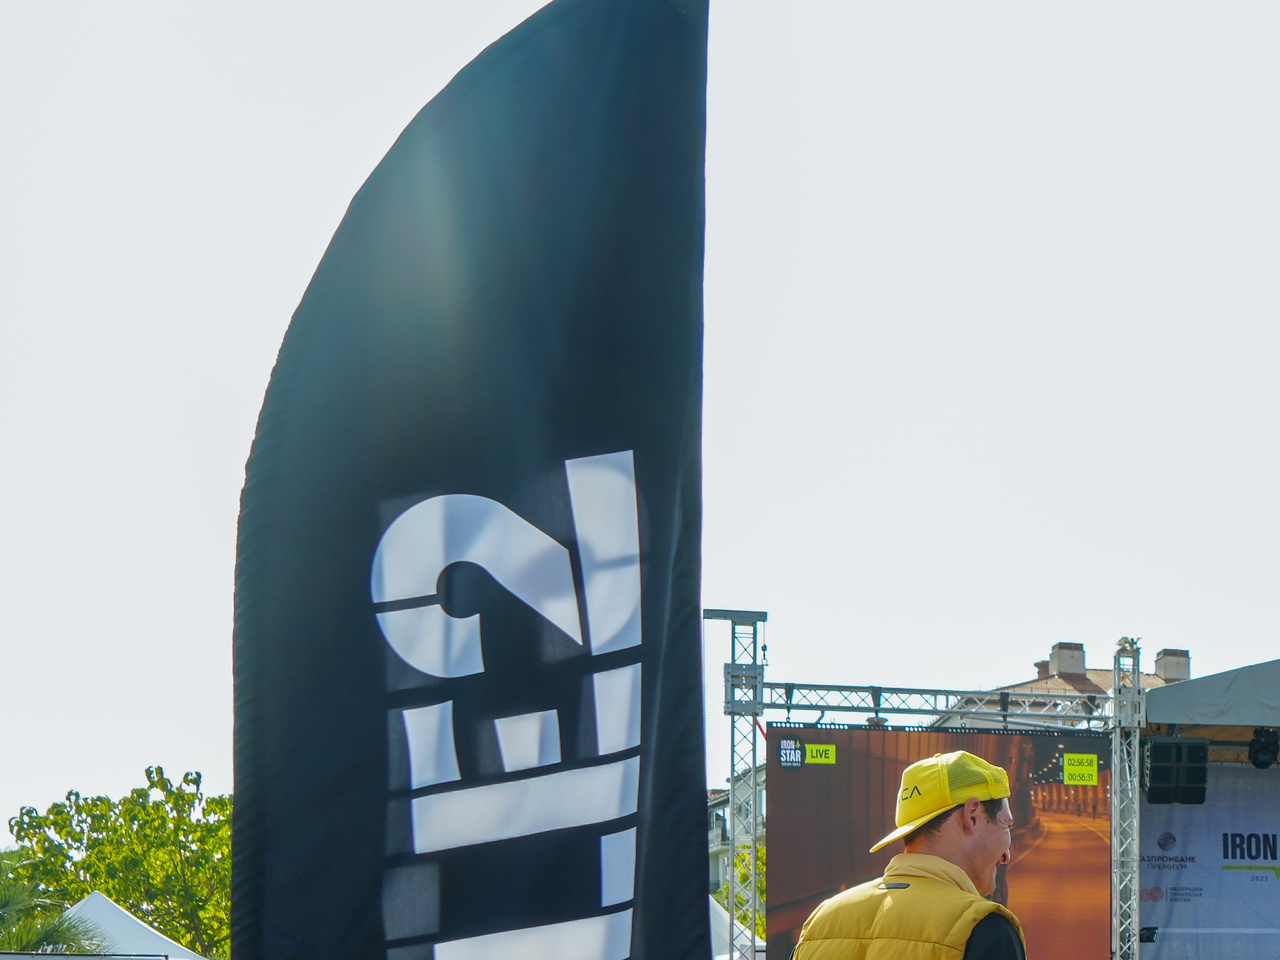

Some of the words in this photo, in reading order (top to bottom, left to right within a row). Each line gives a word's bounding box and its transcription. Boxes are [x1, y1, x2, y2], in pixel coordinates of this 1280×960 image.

[781, 740, 795, 749] IRON
[781, 750, 801, 762] STAR
[811, 749, 830, 759] LIVE
[1068, 758, 1094, 767] 02:56:58
[1068, 773, 1094, 782] 00:56:31
[1222, 833, 1278, 860] IRON
